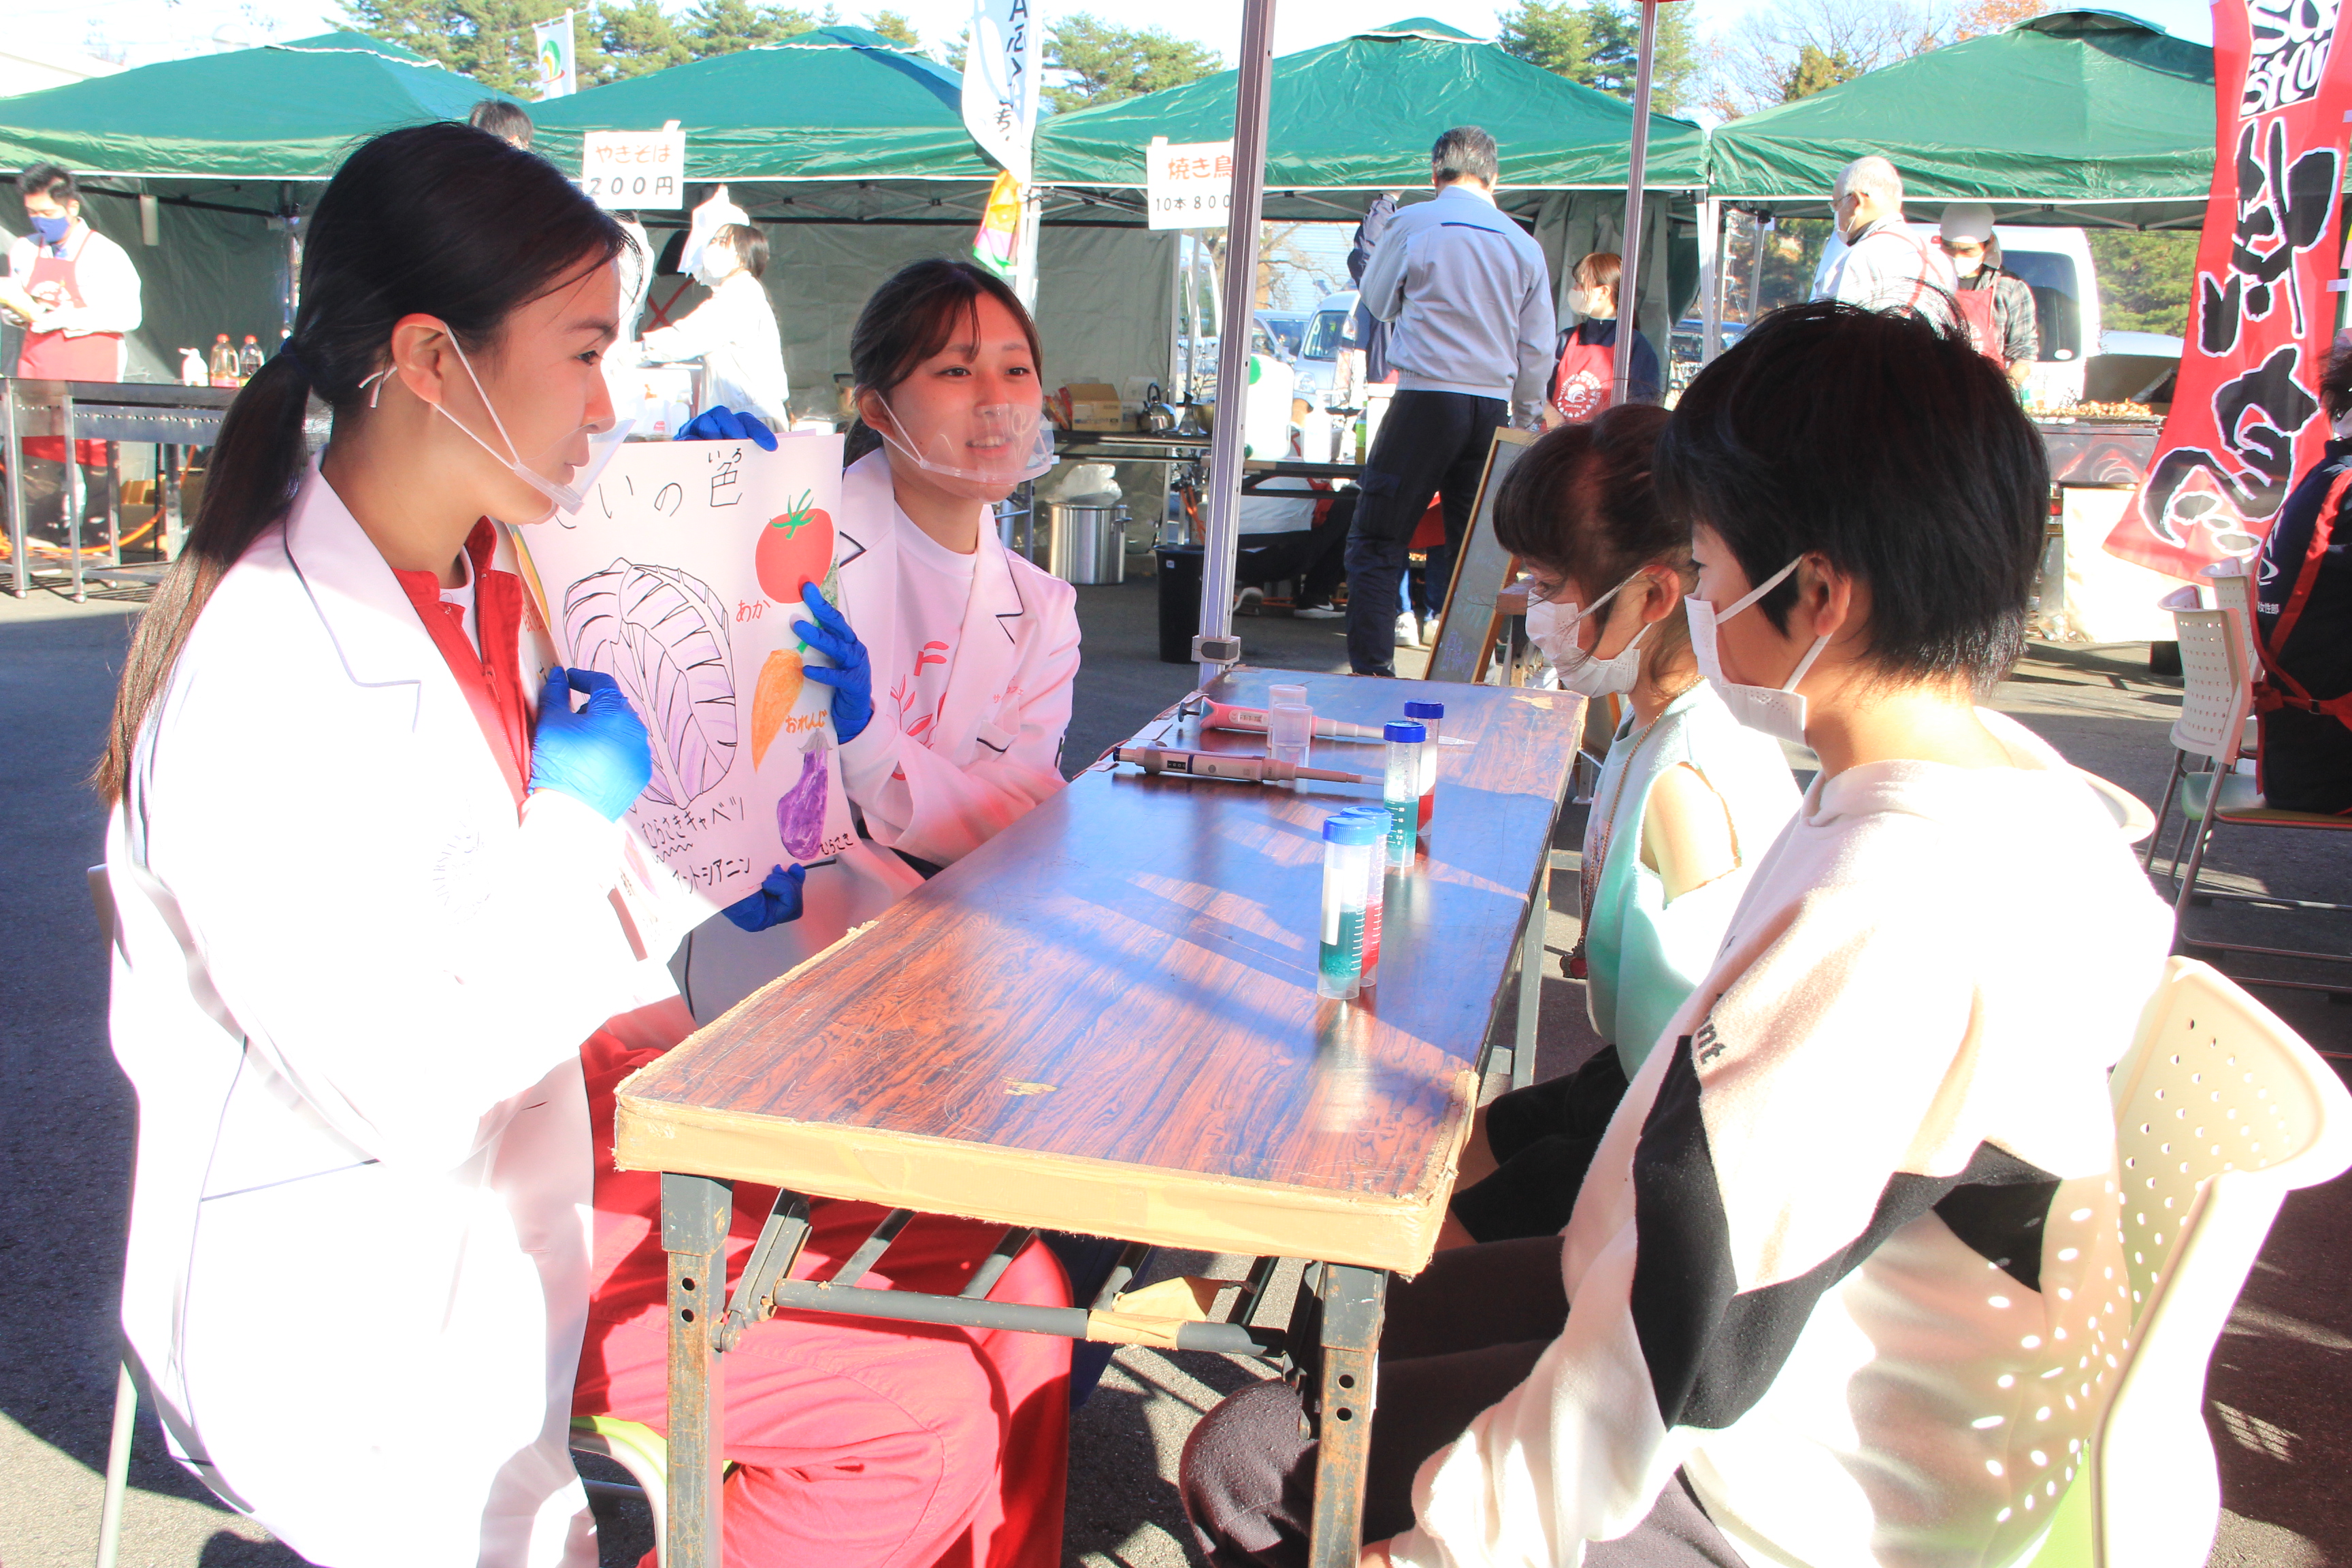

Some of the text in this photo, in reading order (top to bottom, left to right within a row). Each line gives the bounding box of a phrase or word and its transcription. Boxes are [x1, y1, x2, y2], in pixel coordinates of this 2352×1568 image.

[1168, 154, 1234, 180] 焼き鳥
[589, 176, 673, 196] 200円
[708, 447, 742, 464] いろ
[555, 461, 744, 530] いの色
[735, 599, 771, 623] あか
[785, 709, 828, 734] おれんじ
[819, 832, 854, 856] むらさき
